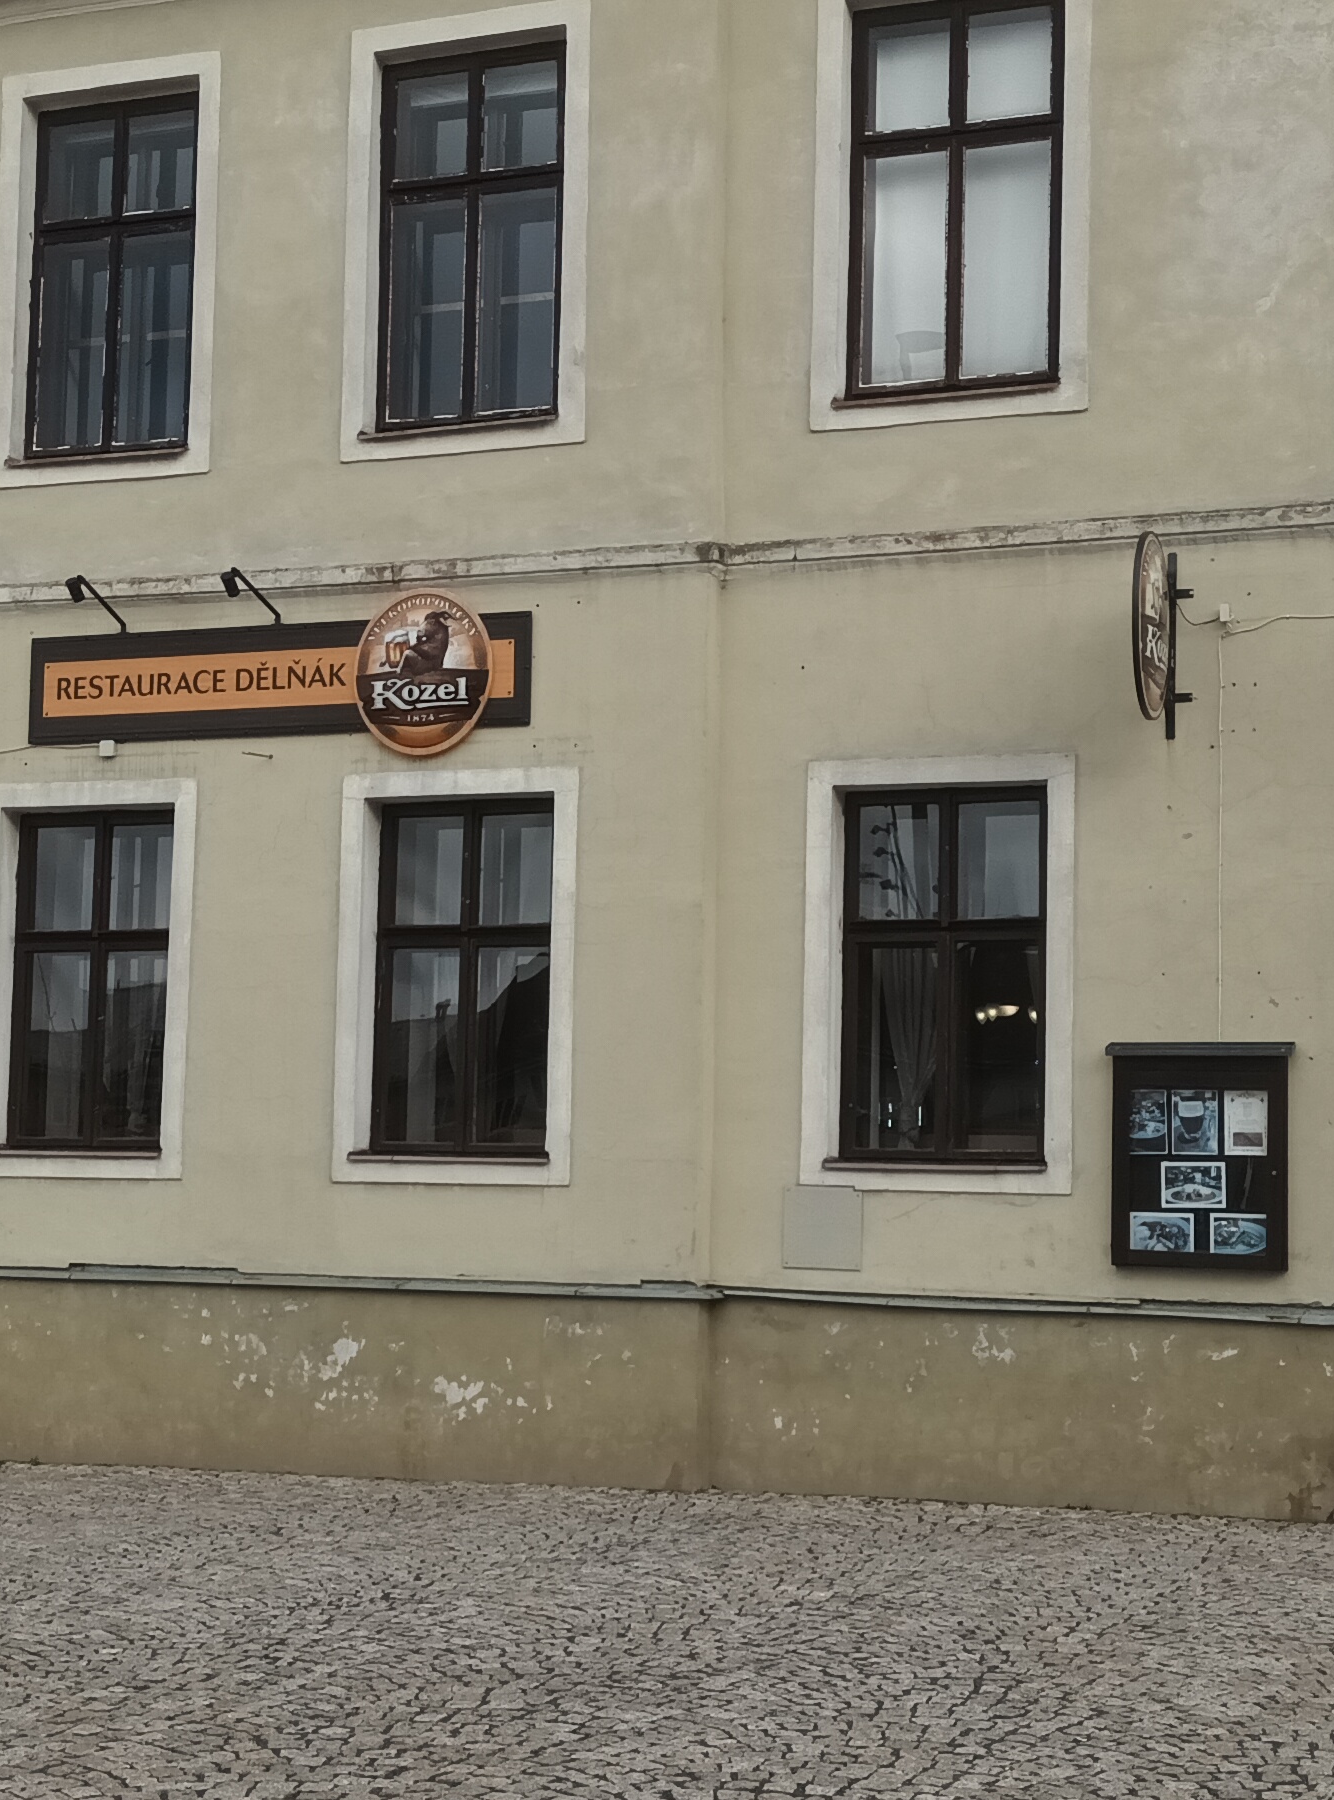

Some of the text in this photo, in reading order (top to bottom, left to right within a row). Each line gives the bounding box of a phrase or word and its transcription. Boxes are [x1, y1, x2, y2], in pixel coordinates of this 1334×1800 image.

[56, 657, 347, 700] RESTAURACE DĚLŇÁK
[370, 676, 470, 710] Kozel
[406, 713, 435, 722] 1874
